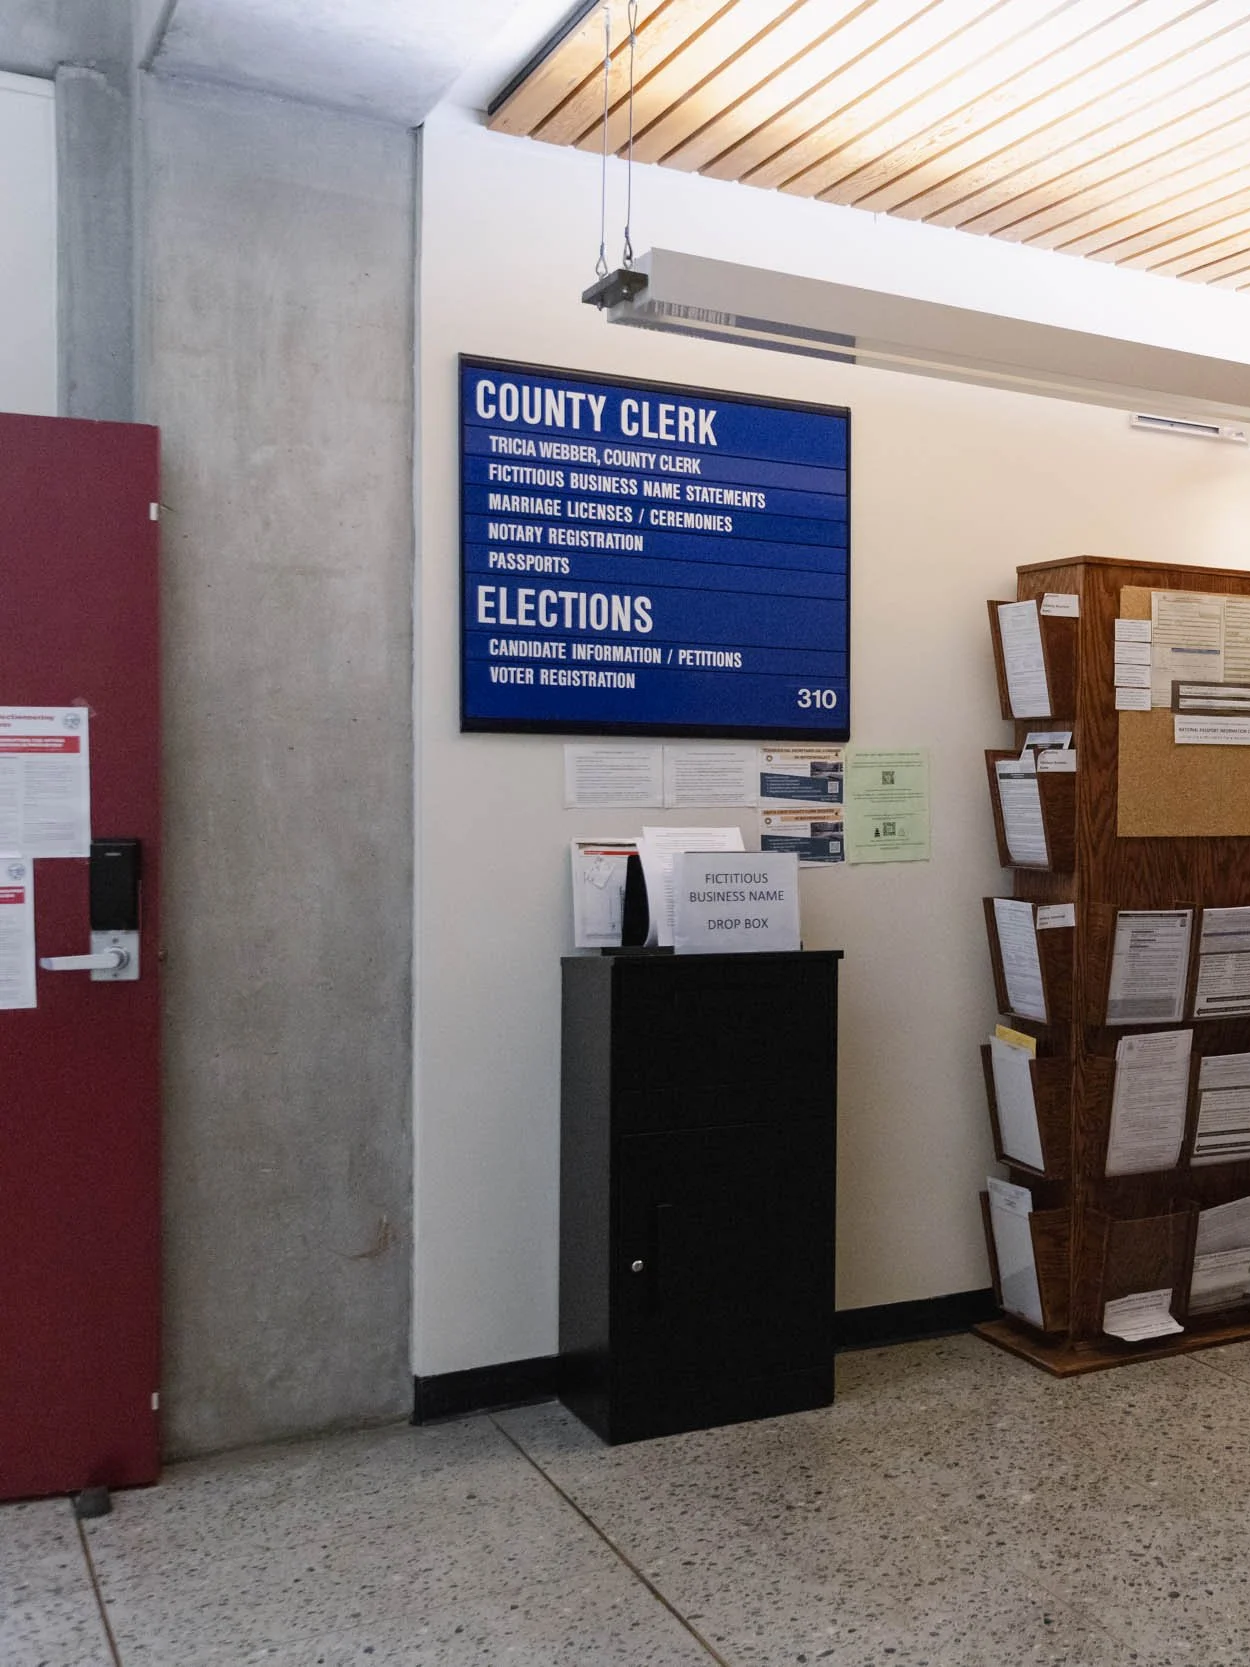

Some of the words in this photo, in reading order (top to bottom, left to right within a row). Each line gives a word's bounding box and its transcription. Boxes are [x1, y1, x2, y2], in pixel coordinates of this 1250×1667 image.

[475, 379, 607, 432] COUNTY
[620, 398, 718, 446] CLERK
[489, 435, 536, 457] TRICIA
[538, 440, 601, 466] WEBBER,
[603, 448, 656, 470] COUNTY
[659, 454, 702, 475] CLERK
[489, 463, 565, 489] FICTITIOUS
[570, 472, 638, 496] BUSINESS
[643, 480, 681, 501] NAME
[685, 484, 766, 509] STATEMENTS
[488, 493, 562, 517] MARRIAGE
[567, 500, 633, 523] LICENSES
[638, 508, 645, 524] /
[650, 508, 733, 533] CEREMONIES
[488, 522, 543, 543] NOTARY
[548, 527, 644, 552] REGISTRATION
[488, 551, 570, 574] PASSPORTS
[477, 585, 653, 634] ELECTIONS
[489, 638, 566, 660] CANDIDATE
[572, 643, 662, 665] INFORMATION
[667, 649, 673, 665] /
[678, 649, 743, 668] PETITIONS
[490, 666, 534, 685] VOTER
[540, 668, 636, 689] REGISTRATION
[797, 688, 837, 709] 310
[704, 872, 769, 885] FICTITIOUS
[689, 890, 746, 903] BUSINESS
[748, 890, 785, 902] NAME
[707, 918, 742, 931] DROP
[743, 917, 769, 930] BOX
